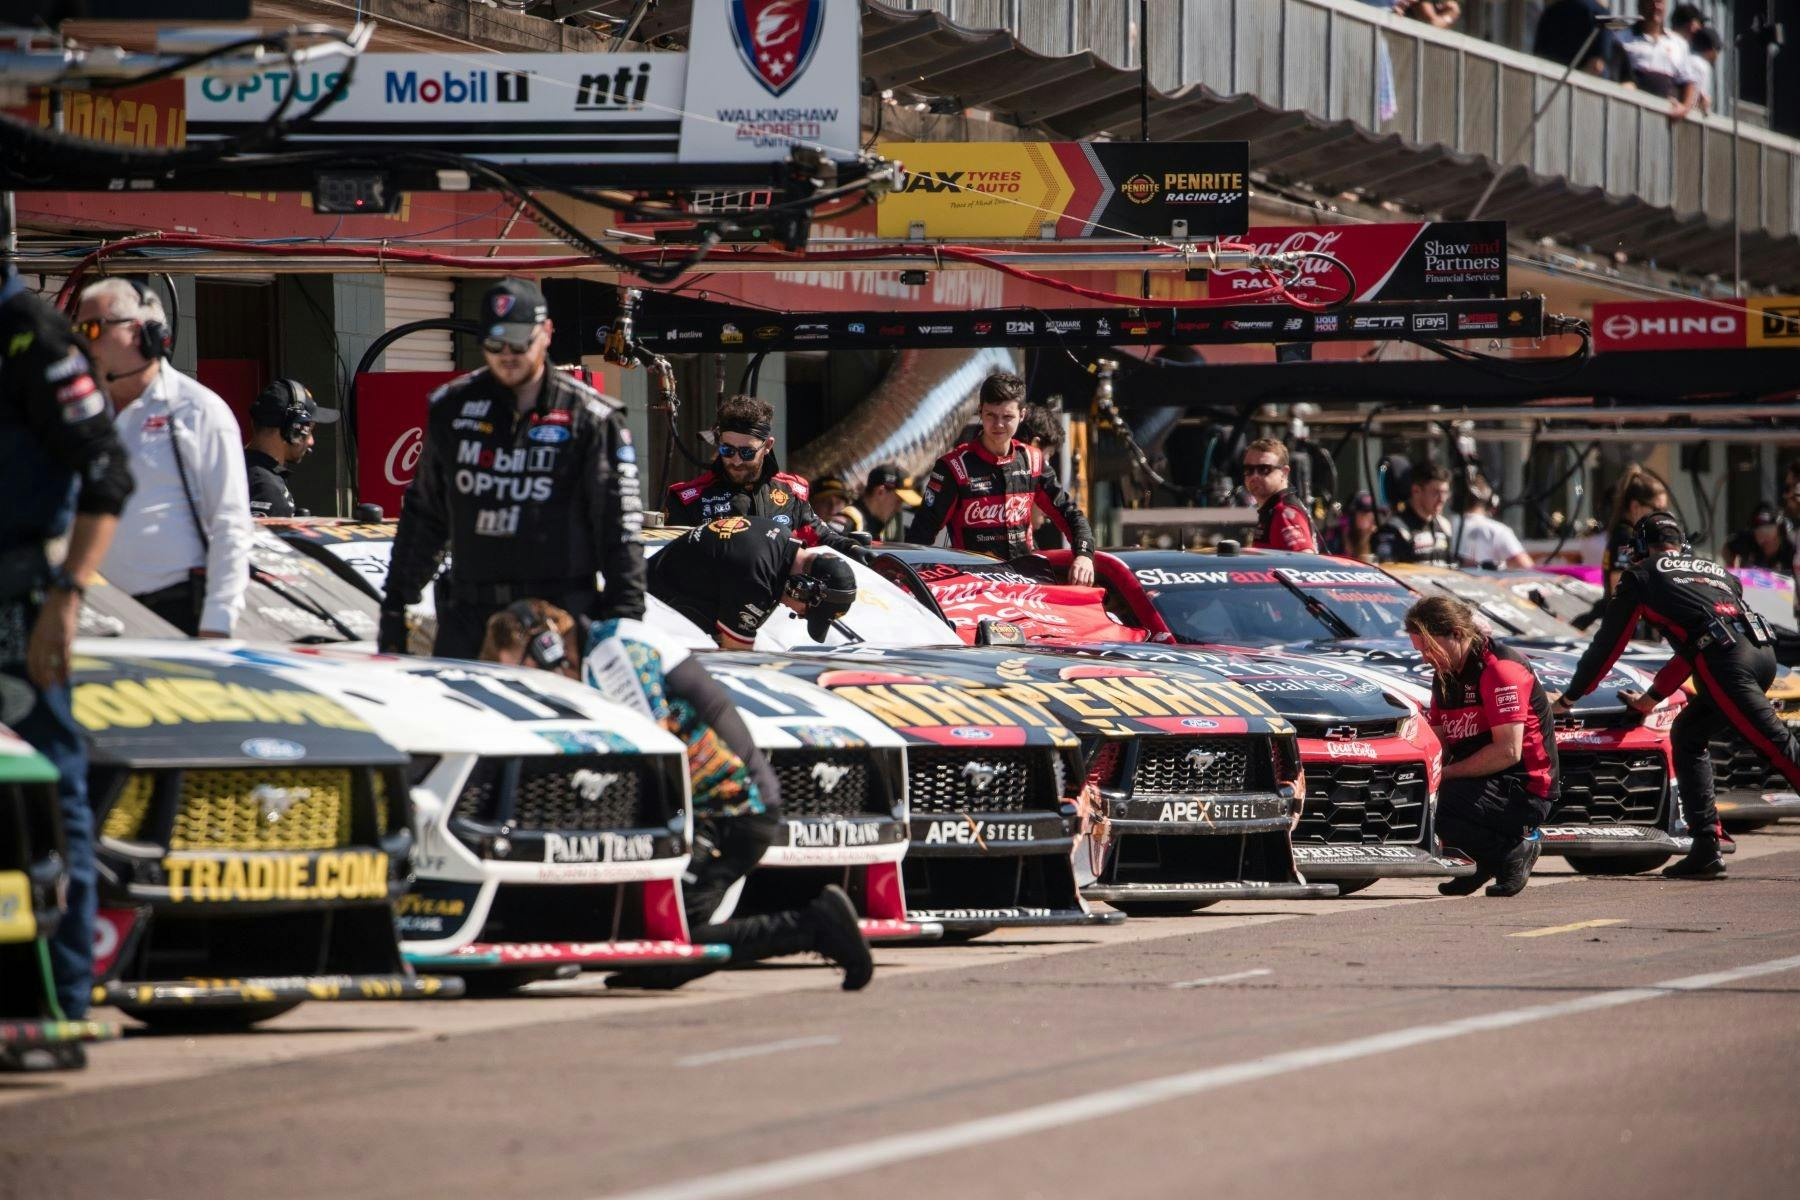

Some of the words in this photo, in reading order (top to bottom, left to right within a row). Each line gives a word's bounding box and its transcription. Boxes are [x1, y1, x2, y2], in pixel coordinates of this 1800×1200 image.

[386, 71, 487, 103] Mobil
[574, 62, 651, 106] nti
[717, 108, 838, 122] WALKINSHAW
[736, 123, 820, 138] ANDRETTI
[890, 171, 965, 194] JAX
[967, 171, 1022, 182] TYRES
[1164, 173, 1243, 190] PENRITE
[976, 183, 1020, 193] AUTO
[1121, 183, 1160, 193] PENRITE
[1165, 193, 1219, 202] RACING
[1424, 240, 1470, 256] Shaw
[1424, 255, 1500, 273] Partners
[1425, 273, 1462, 283] Financial
[1465, 272, 1500, 282] Services
[1314, 315, 1338, 323] LIQUI
[1314, 323, 1338, 331] MOLY
[1354, 316, 1405, 328] SCTR
[1415, 316, 1445, 328] grays
[1641, 316, 1737, 334] HINO
[457, 440, 527, 474] Mobil
[455, 469, 554, 502] OPTUS
[1656, 557, 1727, 578] Coca-Cola
[1135, 568, 1230, 586] Shaw
[1275, 567, 1398, 586] Partners
[1497, 694, 1517, 705] grays
[1159, 800, 1215, 826] APEX
[1214, 804, 1257, 819] STEEL
[787, 820, 834, 848] PALM
[925, 816, 985, 848] APEX
[986, 824, 1035, 842] STEEL
[1540, 826, 1646, 837] DORMER
[543, 832, 600, 863] PALM
[1291, 846, 1357, 859] PRESS
[163, 853, 390, 902] TRADIE.COM
